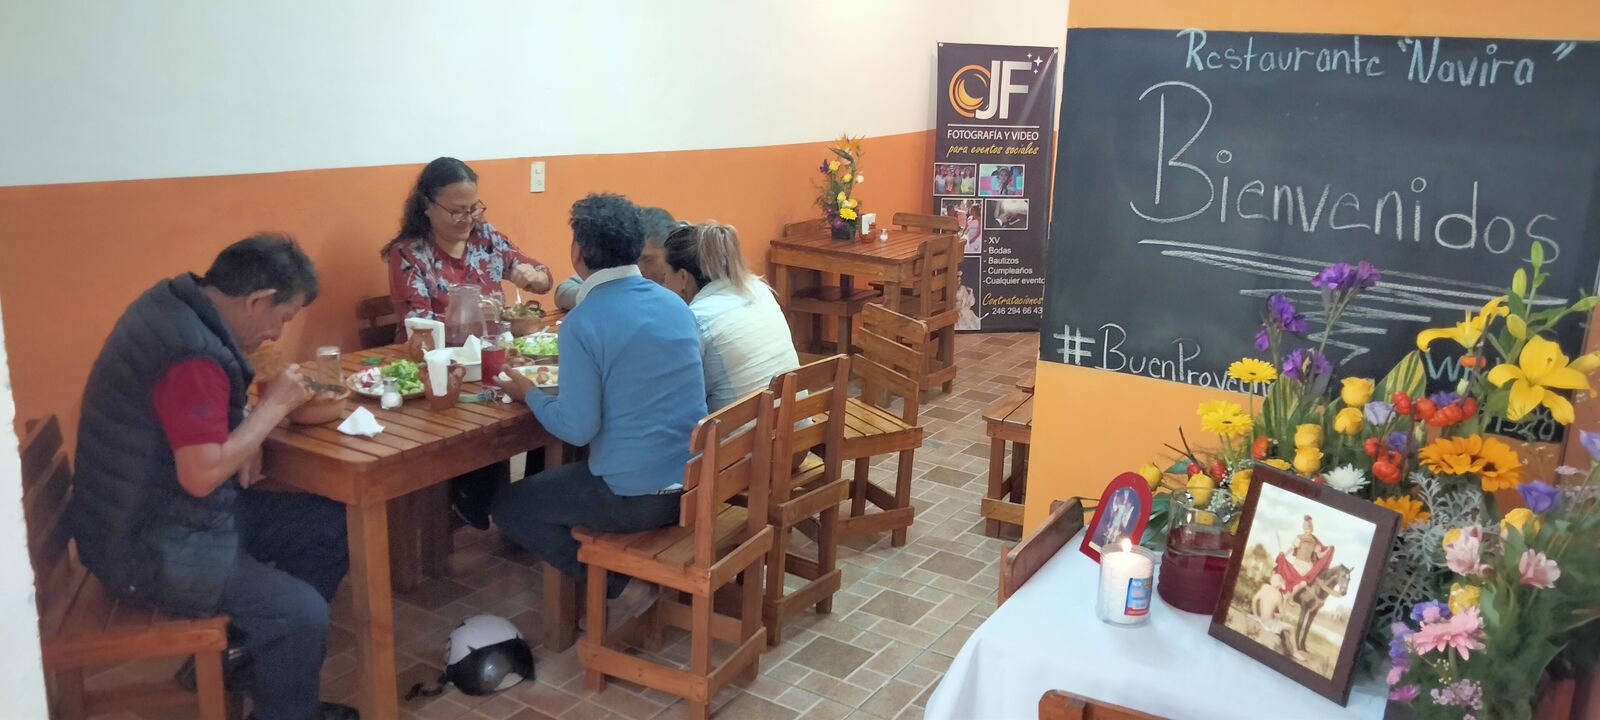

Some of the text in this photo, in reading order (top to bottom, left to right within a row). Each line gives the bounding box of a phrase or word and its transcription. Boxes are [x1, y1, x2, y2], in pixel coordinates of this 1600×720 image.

[1176, 28, 1385, 78] Restaurante
[947, 129, 1040, 141] FOTOGRAFÍA Y VIDEO
[946, 141, 1040, 158] para eventos sociales
[1130, 80, 1560, 263] Bienvenidos
[988, 236, 1001, 245] XV
[988, 246, 1012, 255] Bodas
[988, 256, 1020, 265] Bautizos
[987, 266, 1033, 276] Cumpleaños
[991, 307, 1006, 315] 246
[1007, 307, 1021, 315] 294
